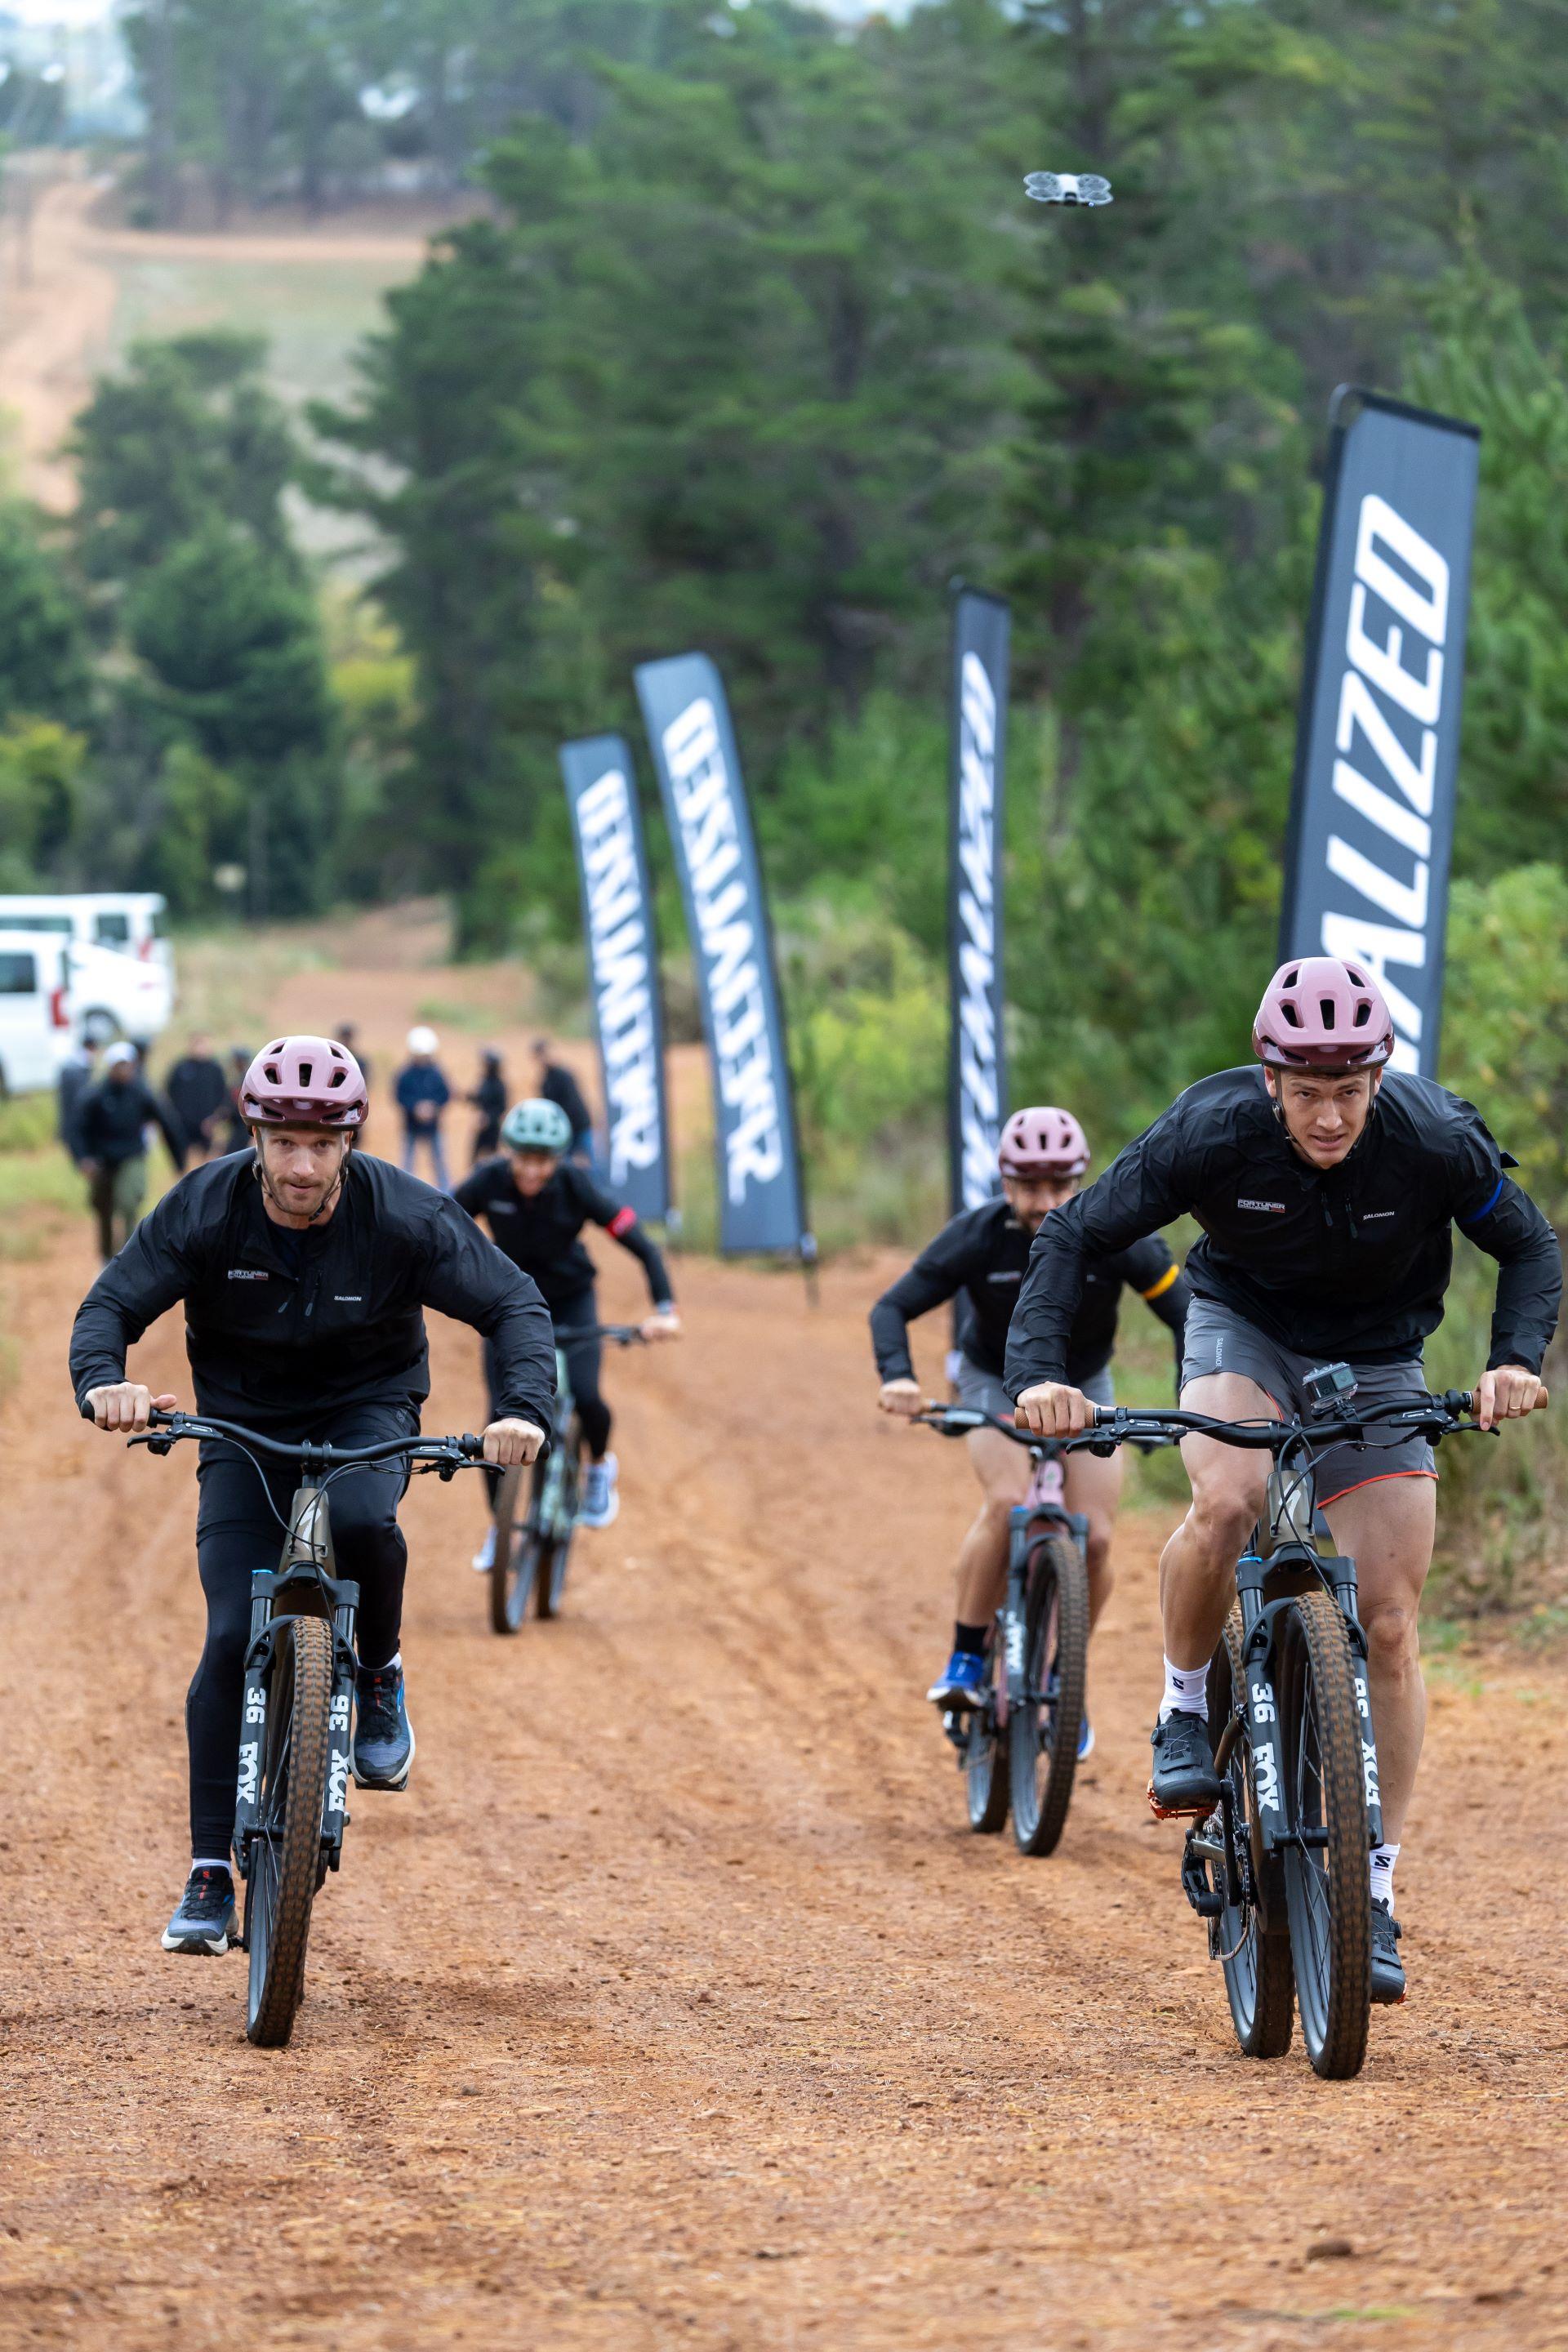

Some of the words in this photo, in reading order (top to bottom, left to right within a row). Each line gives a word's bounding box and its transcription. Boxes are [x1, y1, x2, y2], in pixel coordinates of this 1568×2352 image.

[1237, 1199, 1285, 1209] FORTUNER
[1363, 1211, 1395, 1220] SALOMON
[246, 1687, 266, 1724] 36
[329, 1695, 350, 1732] 36
[1251, 1682, 1276, 1724] 36
[236, 1741, 258, 1806] FOX
[328, 1749, 350, 1812] FOX
[1252, 1742, 1280, 1817] FOX
[1361, 1738, 1382, 1807] FOX
